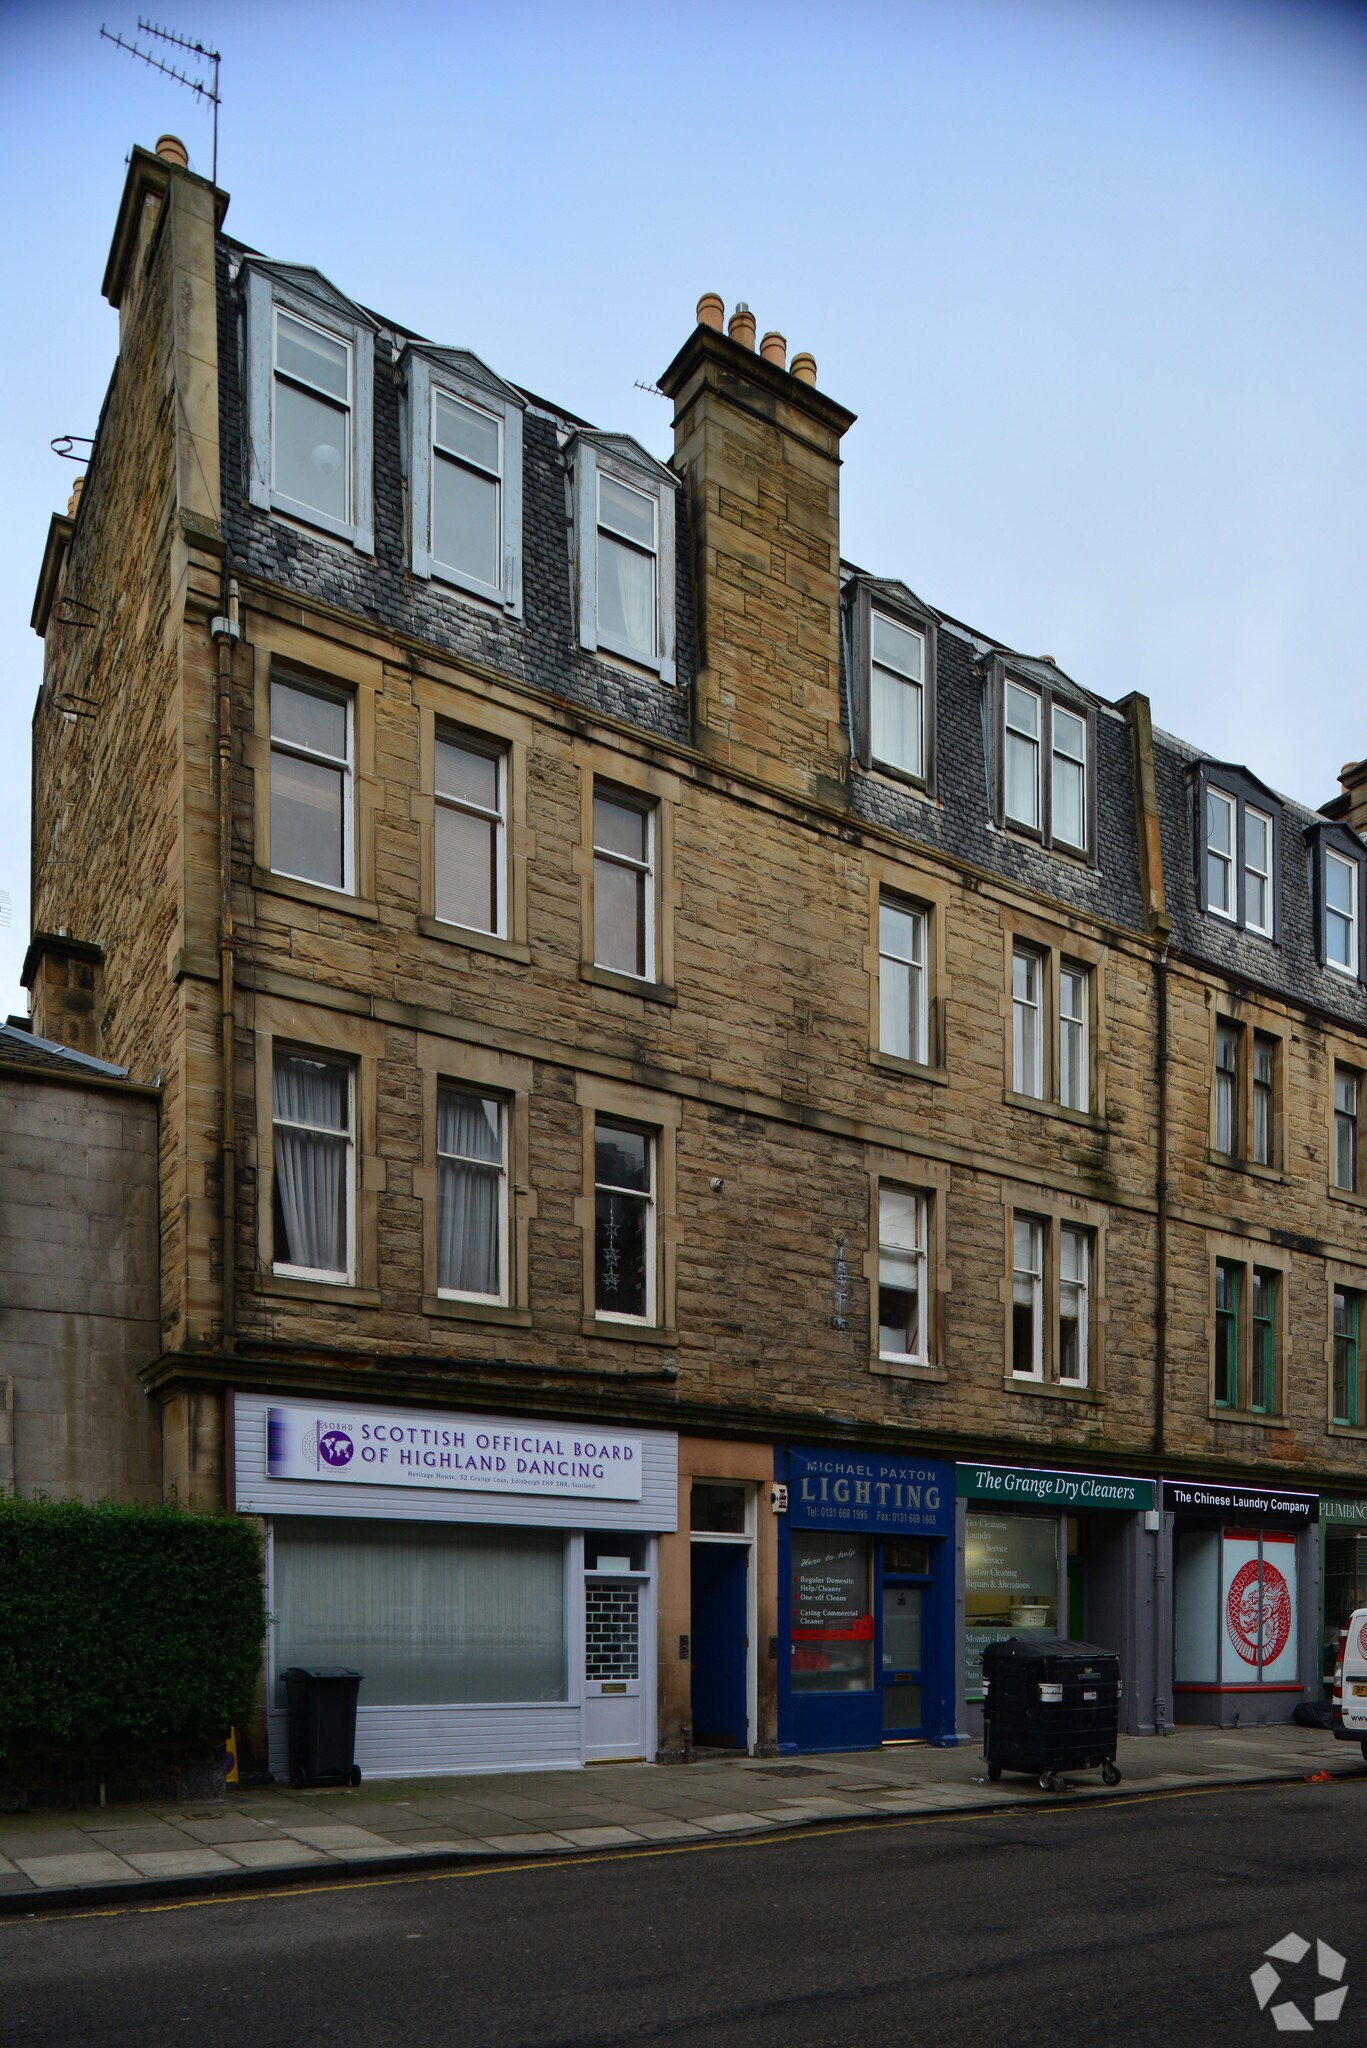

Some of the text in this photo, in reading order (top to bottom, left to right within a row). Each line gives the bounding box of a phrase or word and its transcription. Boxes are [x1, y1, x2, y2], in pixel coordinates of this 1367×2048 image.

[324, 1422, 353, 1431] SOBHD
[361, 1424, 634, 1461] SCOTTISH OFFICIAL BOARD
[361, 1446, 605, 1479] OF HIGHLAND DANCING
[807, 1461, 936, 1481] MICHAEL PAXTON
[407, 1471, 434, 1479] Heritage
[470, 1475, 491, 1483] Grange
[511, 1478, 541, 1486] Edinburgh
[975, 1470, 1135, 1500] The Grange Dry Cleaners
[800, 1477, 941, 1511] LIGHTING
[1174, 1490, 1310, 1515] The Chinese Laundry Company
[806, 1506, 820, 1517] Tel:
[820, 1507, 837, 1518] 0131
[838, 1508, 851, 1519] 668
[853, 1509, 868, 1520] 1995
[876, 1510, 891, 1522] Fax:
[892, 1512, 908, 1523] 0131
[966, 1518, 1007, 1530] Dry Cleaning
[966, 1530, 993, 1542] Laundry
[986, 1543, 1009, 1553] Service
[800, 1547, 856, 1568] Here to help
[990, 1568, 1018, 1578] Cleaning
[800, 1575, 854, 1585] Regular Domestic
[966, 1579, 1030, 1590] Repairs & Alterations
[800, 1585, 842, 1593] Help/Cleaner
[800, 1609, 858, 1618] Caring Commercial
[800, 1617, 824, 1625] Cleaner
[965, 1633, 992, 1643] Monday
[966, 1647, 980, 1655] 9am
[966, 1671, 980, 1679] 9am
[1355, 1685, 1367, 1694] BF
